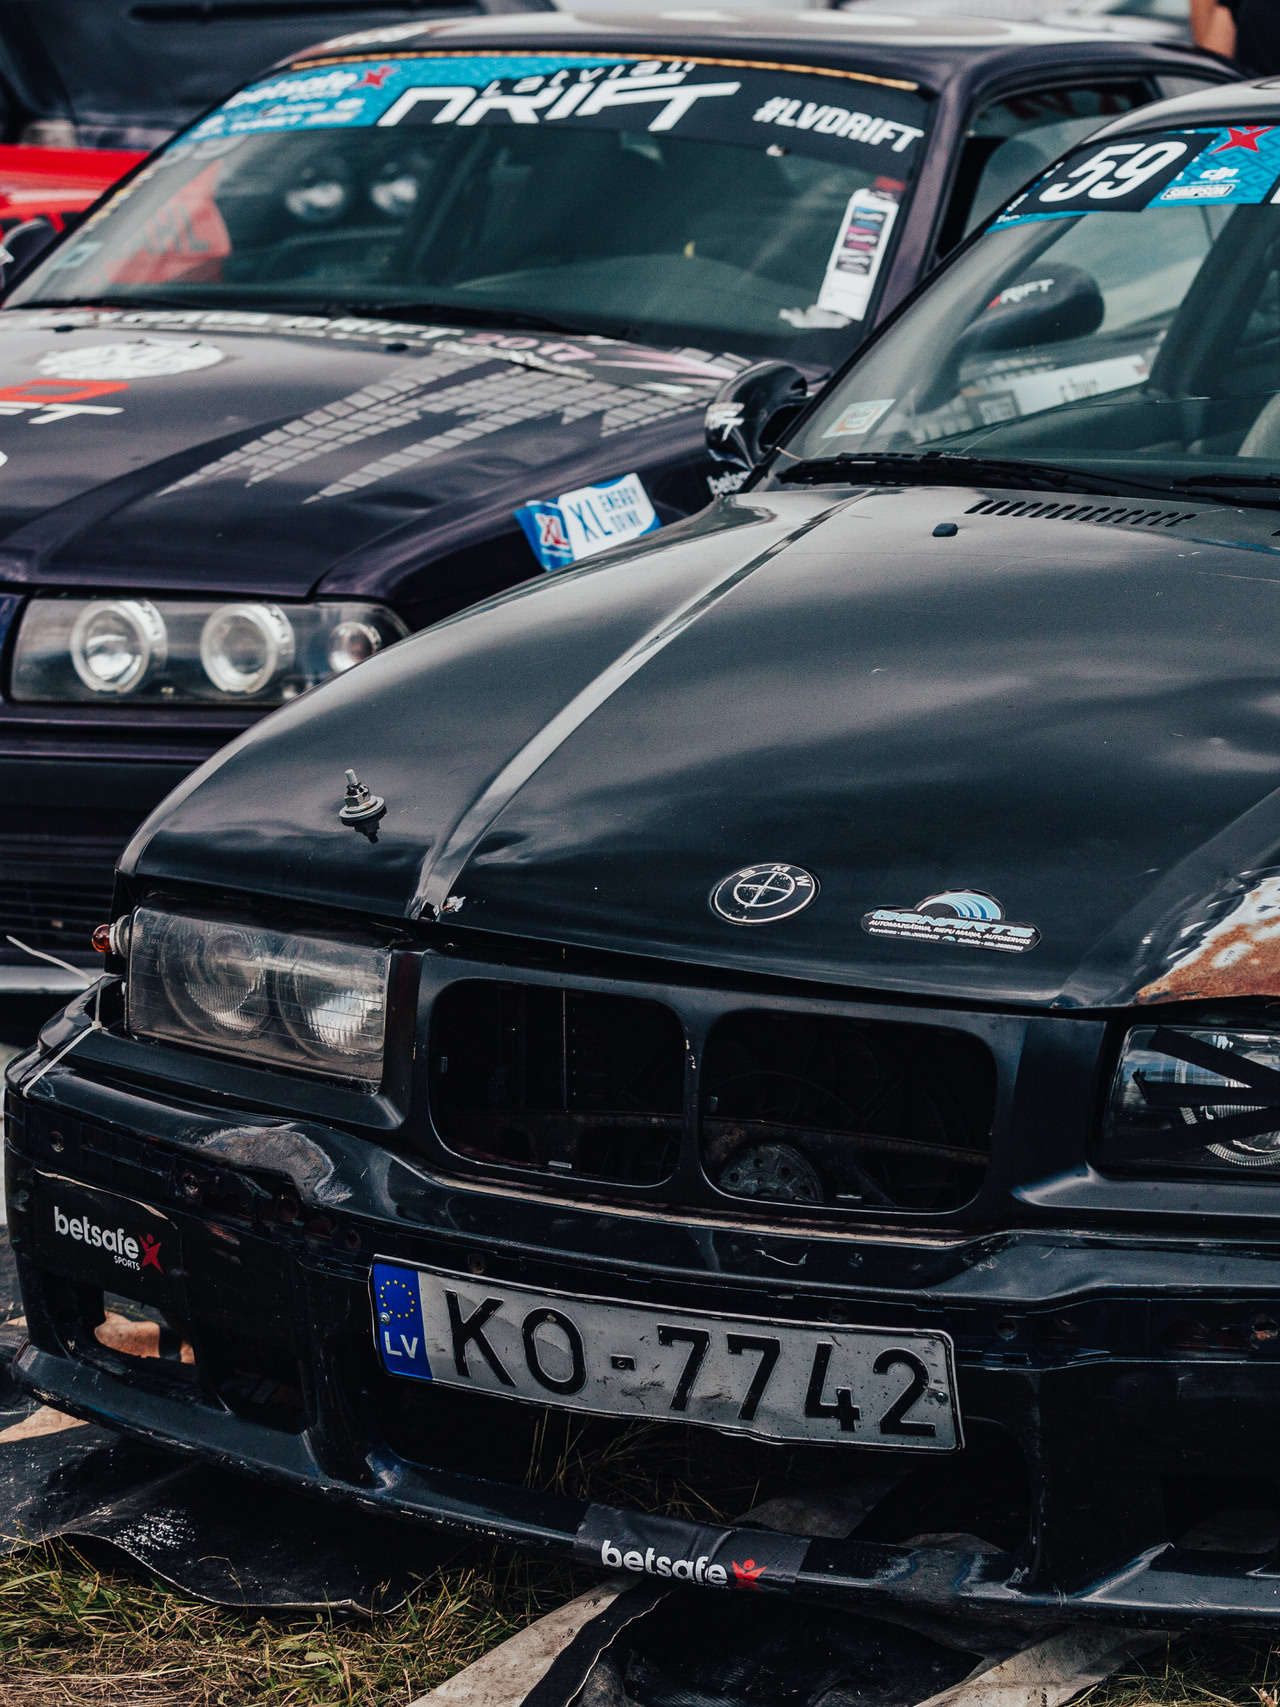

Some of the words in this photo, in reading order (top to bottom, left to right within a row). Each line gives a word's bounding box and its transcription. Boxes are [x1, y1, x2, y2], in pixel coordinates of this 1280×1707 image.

[376, 71, 742, 132] DRIFT
[752, 96, 926, 153] #LVDRIFT
[1038, 140, 1190, 203] 59
[53, 1205, 140, 1260] betsafe
[113, 1255, 141, 1271] SPORTS
[384, 1330, 419, 1359] LV
[601, 1539, 728, 1586] betsafe
